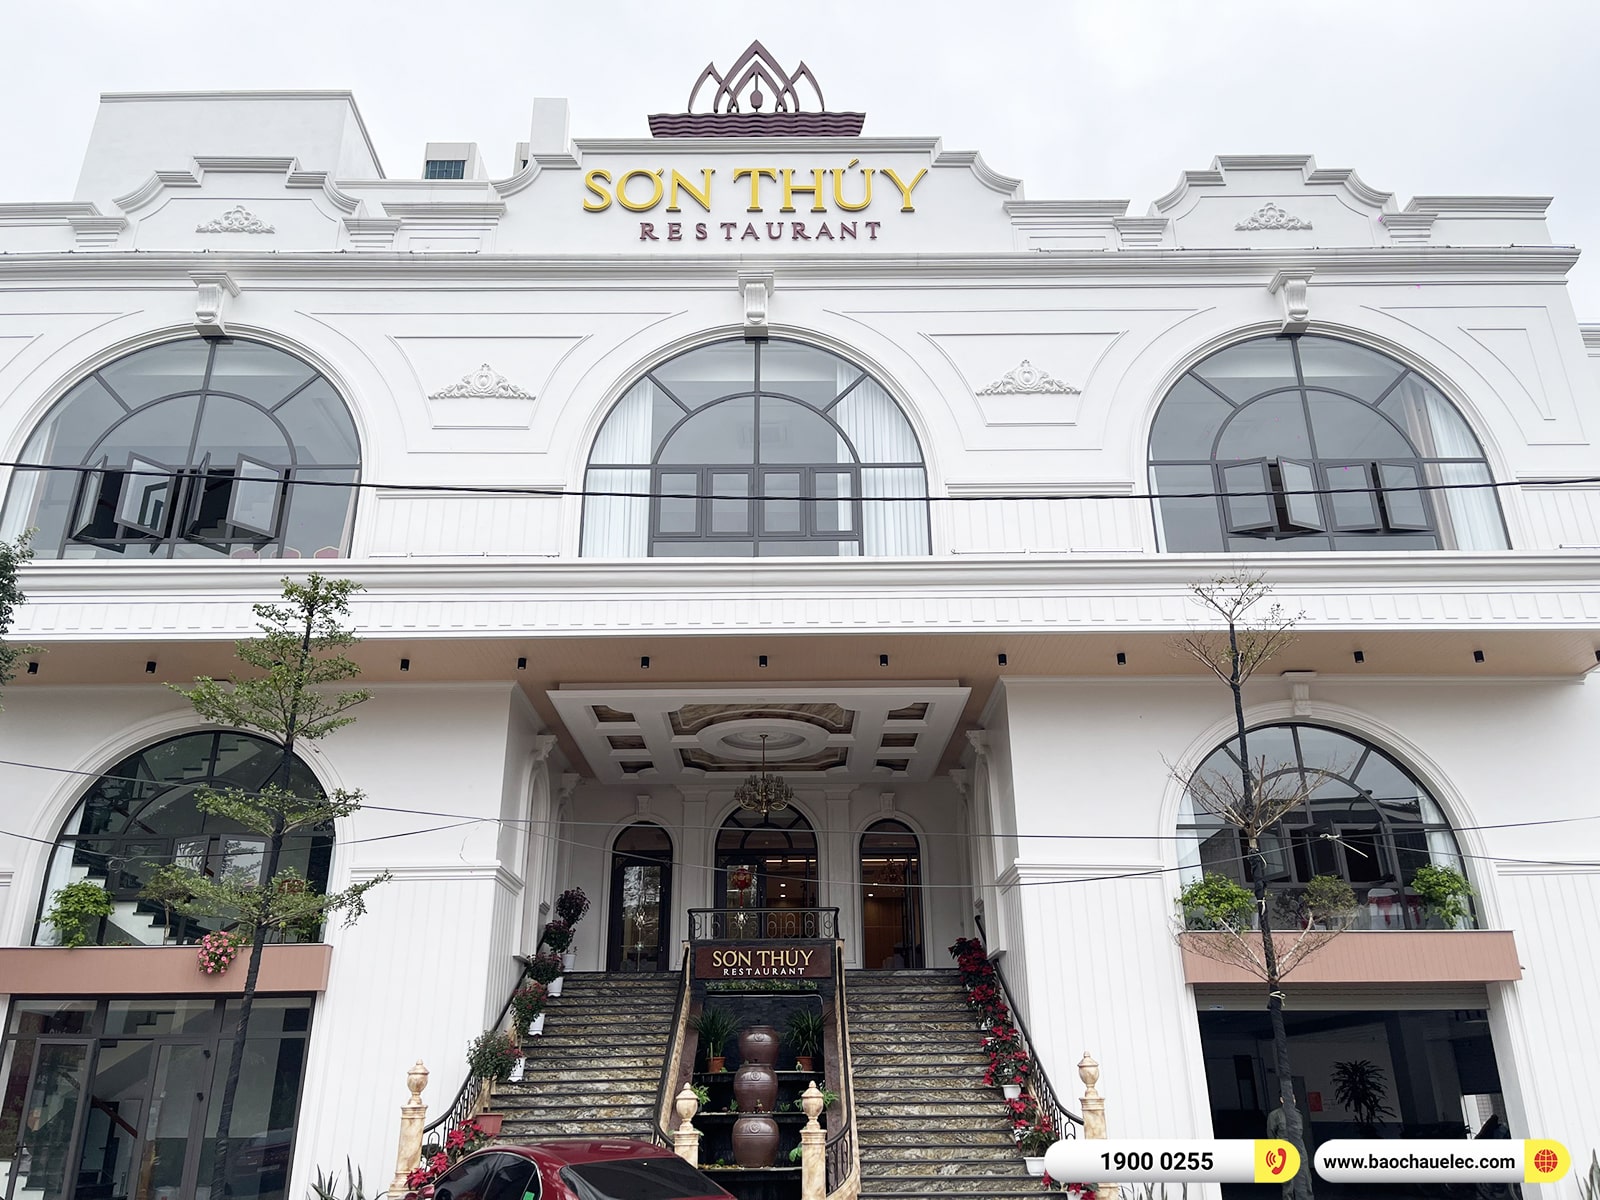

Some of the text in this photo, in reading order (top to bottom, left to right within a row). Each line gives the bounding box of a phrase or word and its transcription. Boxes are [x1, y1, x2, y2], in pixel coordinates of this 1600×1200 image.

[583, 158, 928, 212] SƠN THÚY
[639, 222, 881, 241] RESTAURANT
[712, 947, 814, 967] SƠN THÚY
[723, 967, 805, 976] RESTAURANT
